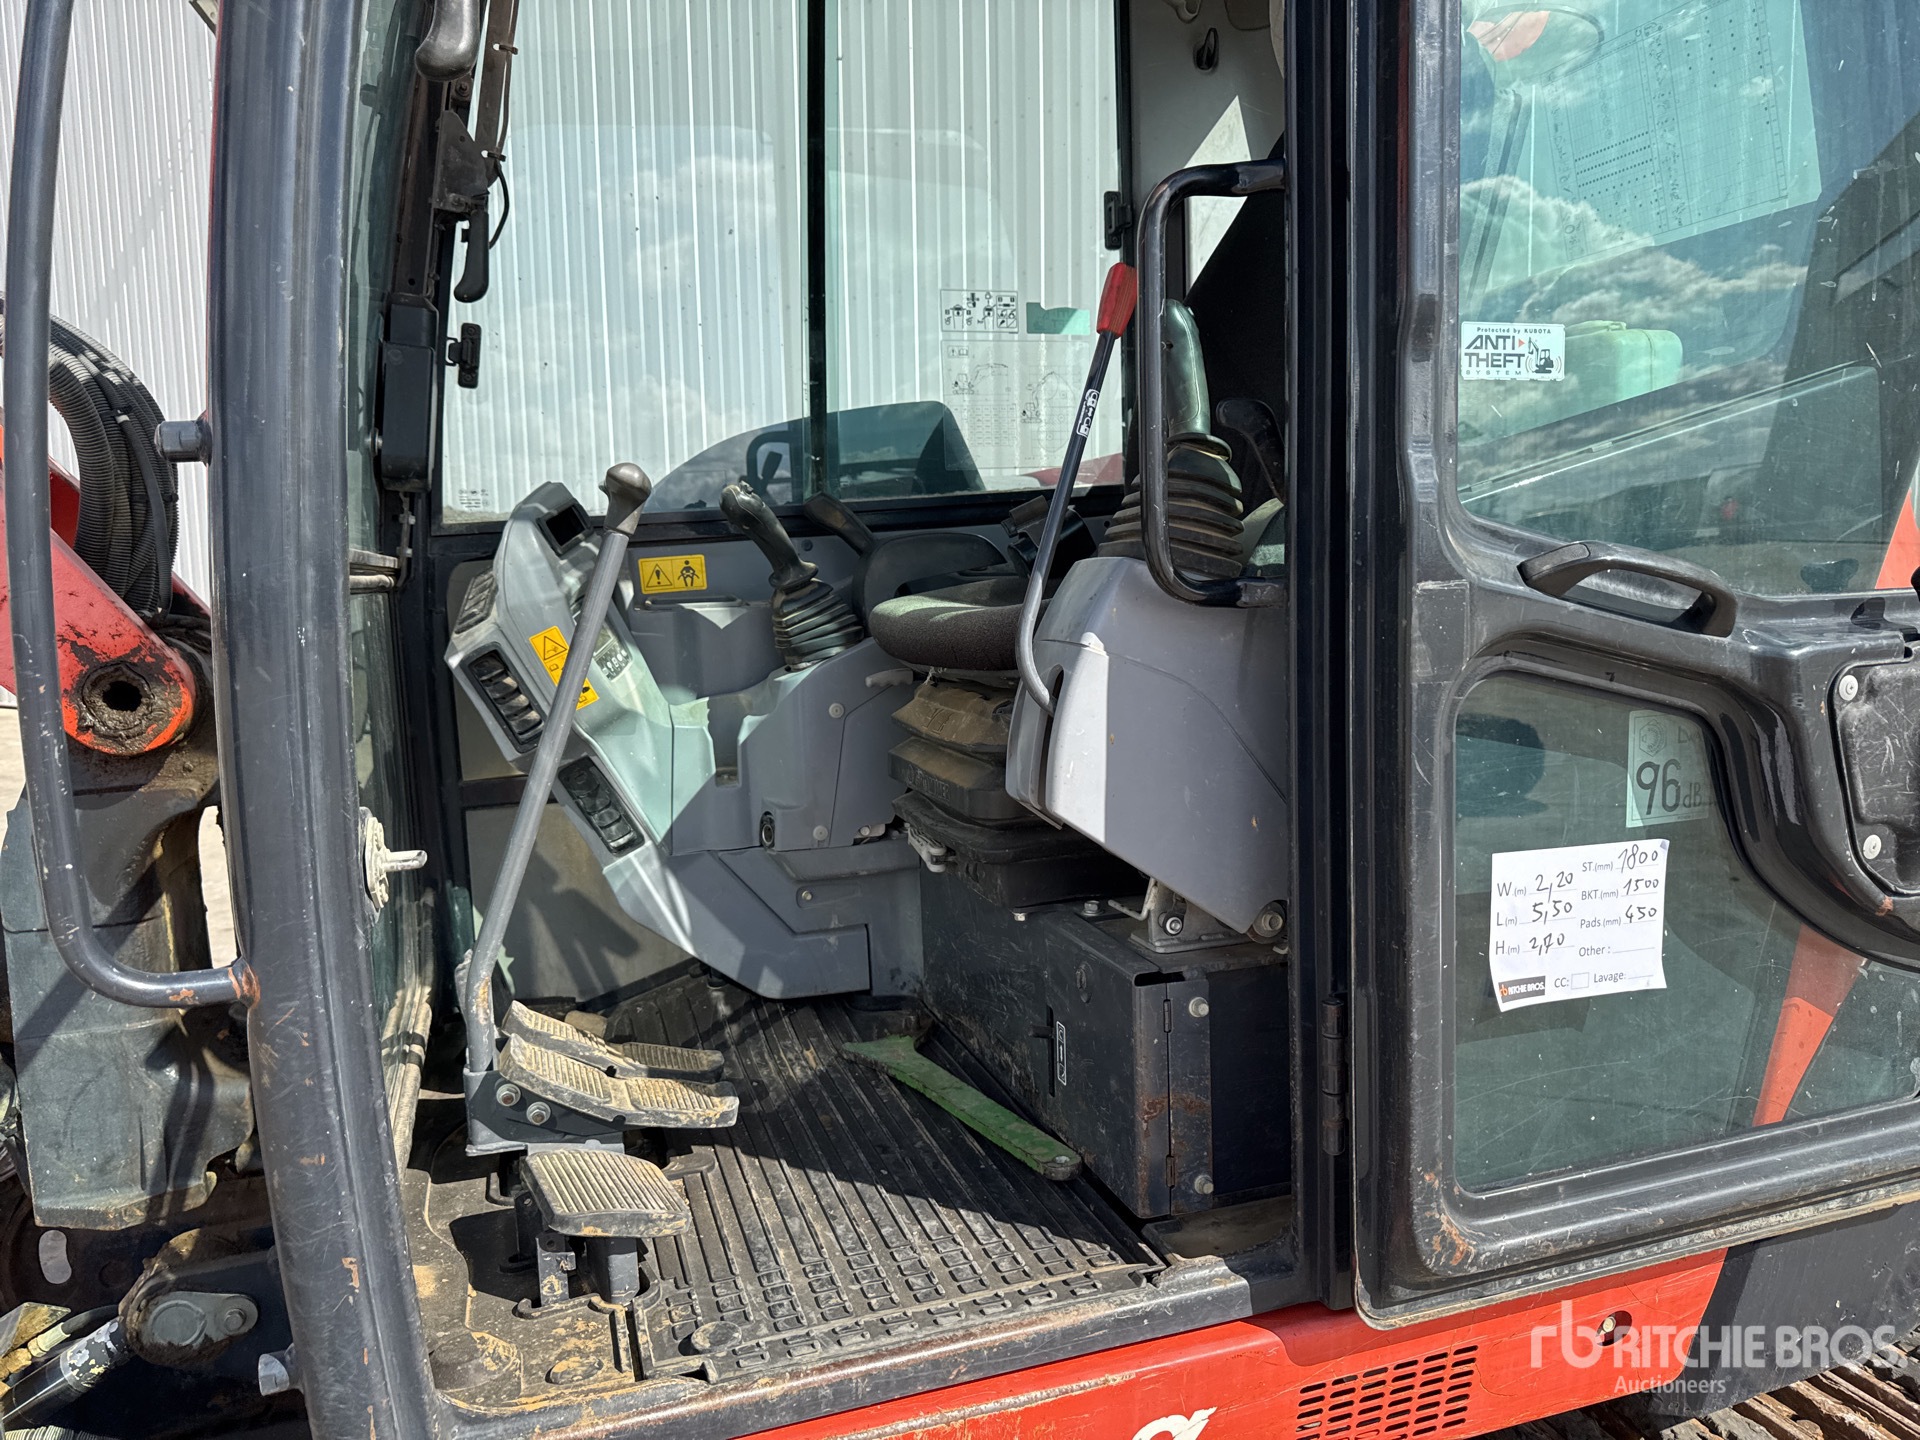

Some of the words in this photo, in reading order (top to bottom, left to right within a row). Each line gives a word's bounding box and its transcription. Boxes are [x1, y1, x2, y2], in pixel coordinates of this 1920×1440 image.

[1465, 334, 1515, 350] ANTI
[1464, 352, 1525, 368] THEFT
[1636, 759, 1681, 815] 96
[1683, 782, 1702, 808] dB
[1618, 844, 1658, 873] 1800
[1535, 871, 1573, 903] 2,20
[1623, 878, 1659, 895] 1500
[1532, 900, 1573, 925] 5,50
[1625, 905, 1657, 923] 450
[1554, 977, 1569, 988] CC:
[1593, 972, 1626, 983] Lavage:
